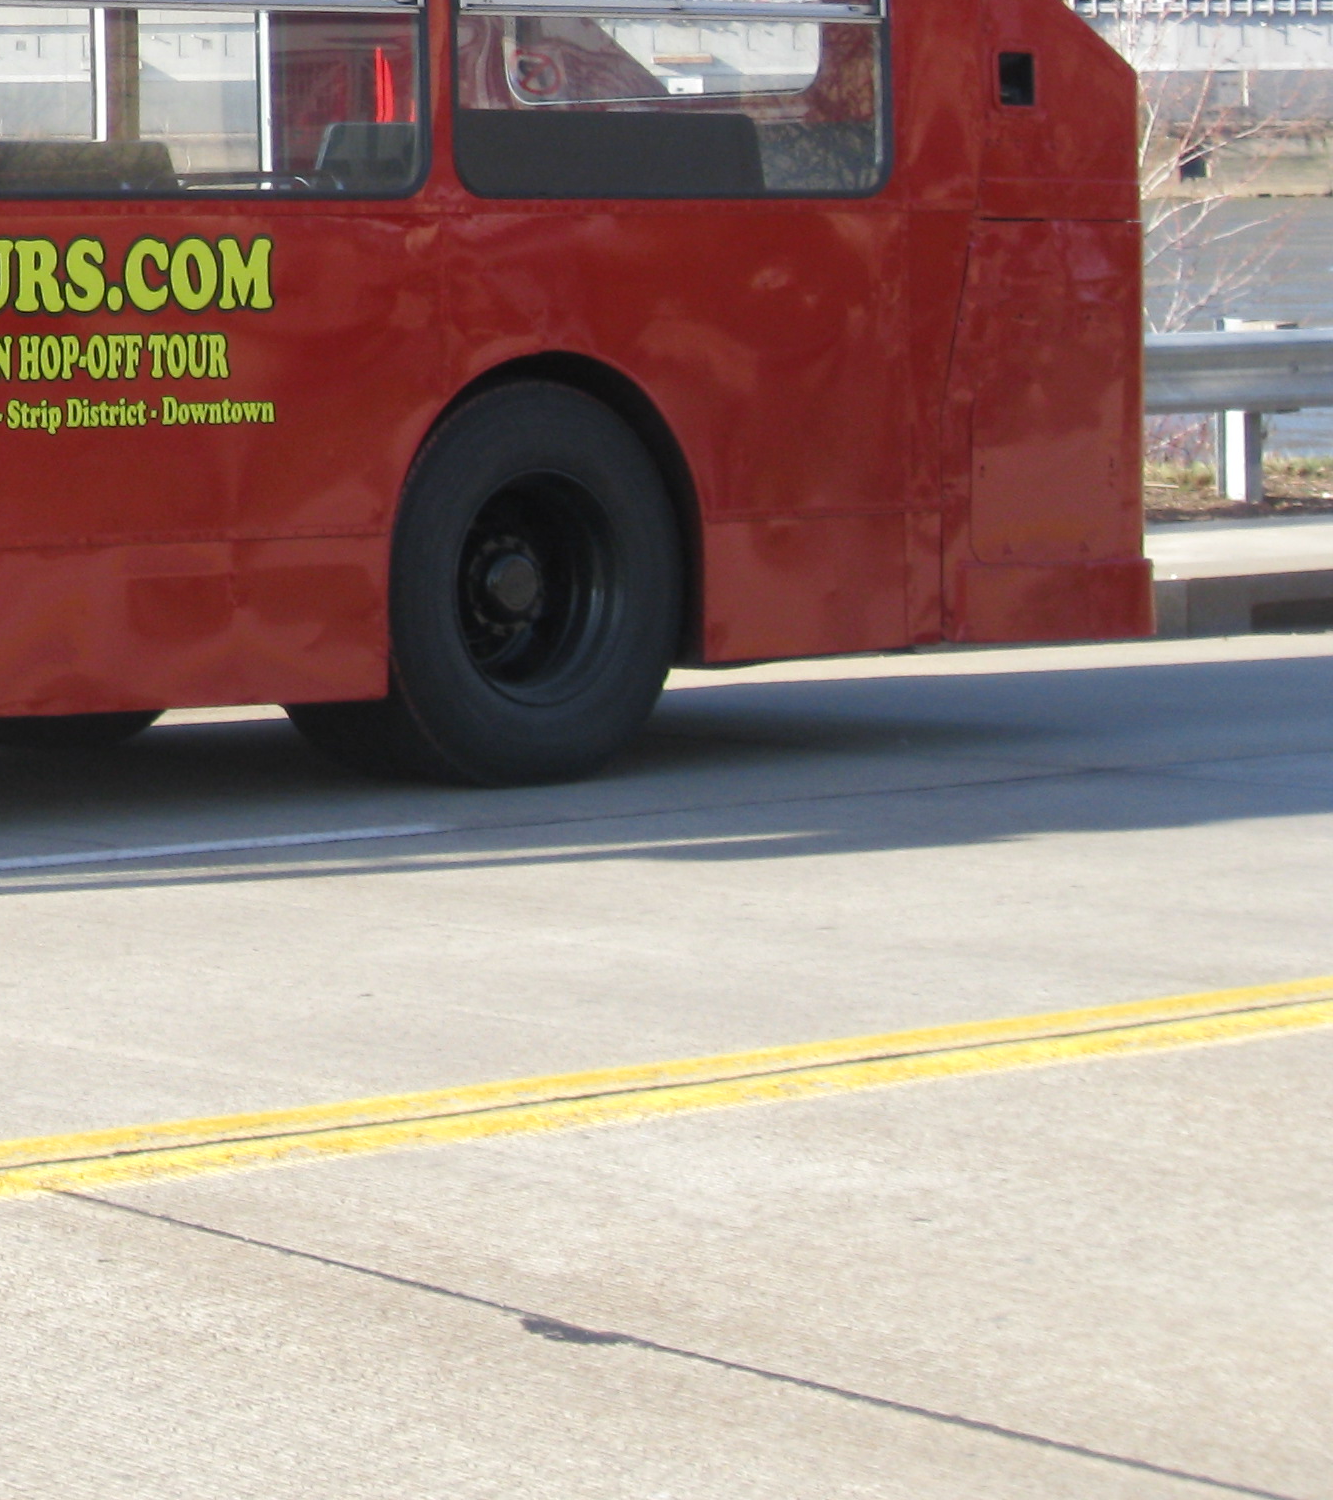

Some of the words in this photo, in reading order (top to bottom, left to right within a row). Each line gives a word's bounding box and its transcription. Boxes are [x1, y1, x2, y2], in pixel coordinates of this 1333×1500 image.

[18, 334, 143, 381] HOP-OFF
[148, 334, 229, 379] TOUR
[7, 399, 62, 435] Strip
[66, 398, 147, 428] District
[162, 397, 275, 425] Downtown
